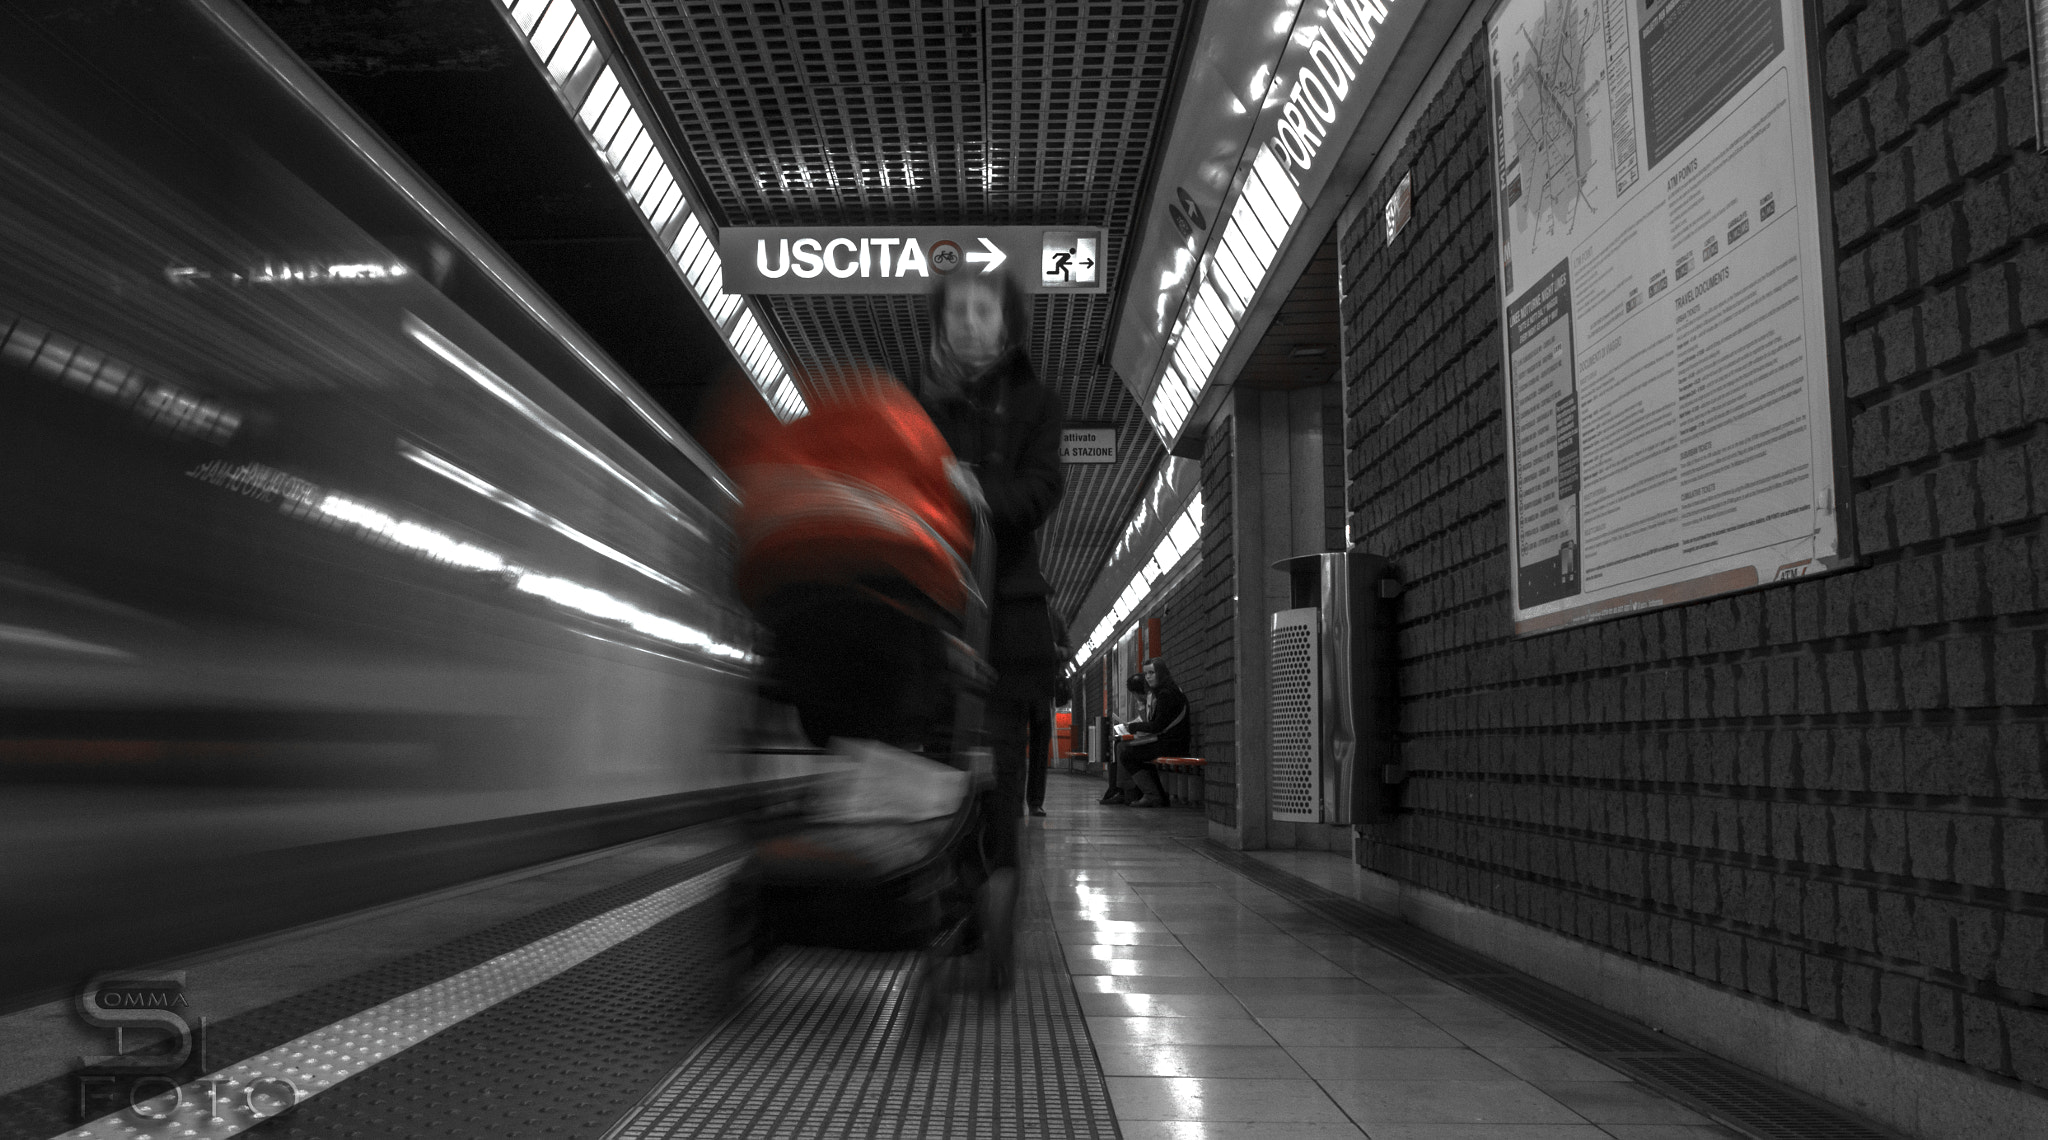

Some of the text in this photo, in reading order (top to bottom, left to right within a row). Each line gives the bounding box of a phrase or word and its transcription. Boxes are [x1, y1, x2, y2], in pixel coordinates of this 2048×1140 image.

[1270, 0, 1390, 187] PORTO DI MA
[757, 238, 929, 278] USCITA
[1674, 289, 1694, 310] TRAVEL
[1694, 266, 1729, 298] DOCUMENTS
[1063, 433, 1096, 442] attivato
[1072, 447, 1113, 457] STAZIONE
